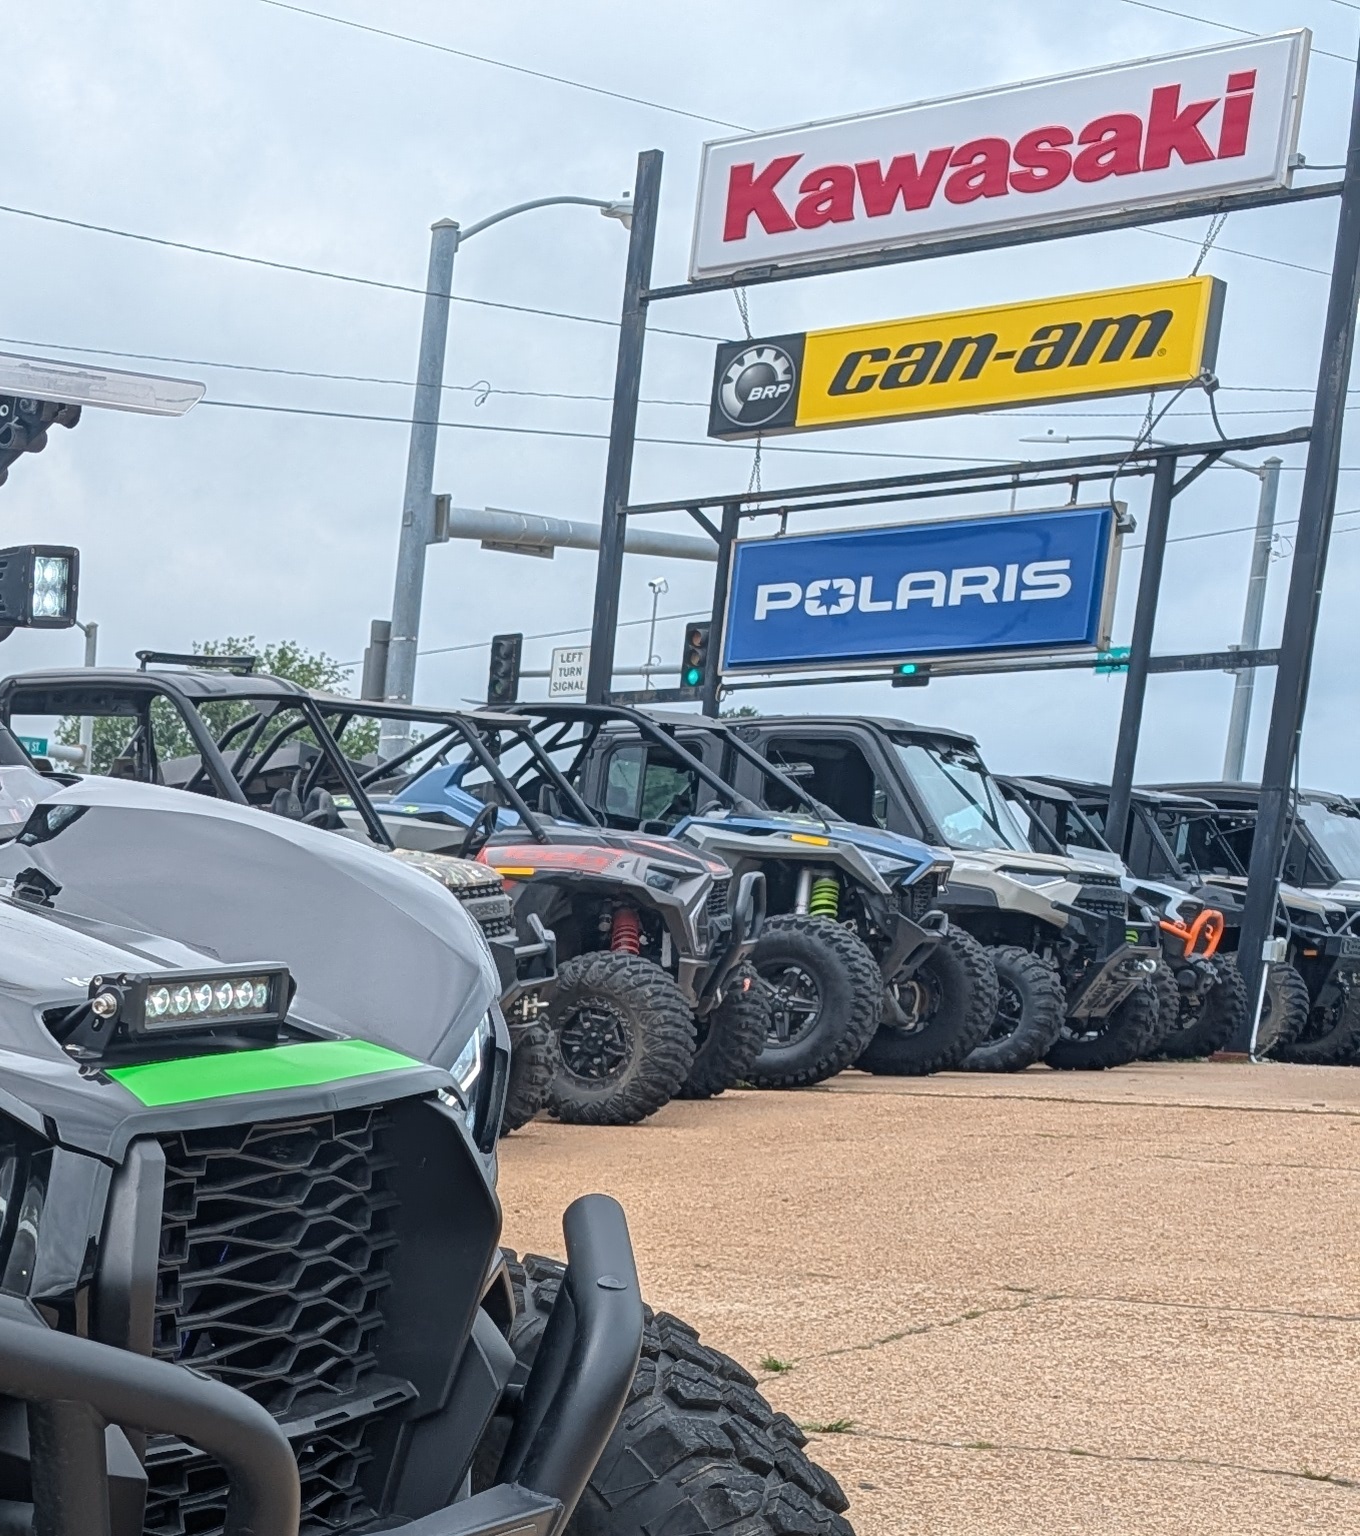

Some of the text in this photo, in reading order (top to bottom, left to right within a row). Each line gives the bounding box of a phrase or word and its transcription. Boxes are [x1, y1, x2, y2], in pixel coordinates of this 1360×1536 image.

[722, 69, 1256, 242] Kawasaki
[826, 309, 1174, 397] can-am
[746, 383, 791, 401] BRP
[754, 559, 1072, 621] POLARIS
[560, 651, 584, 664] LEFT
[558, 666, 583, 678] TURN
[552, 680, 585, 692] SIGNAL
